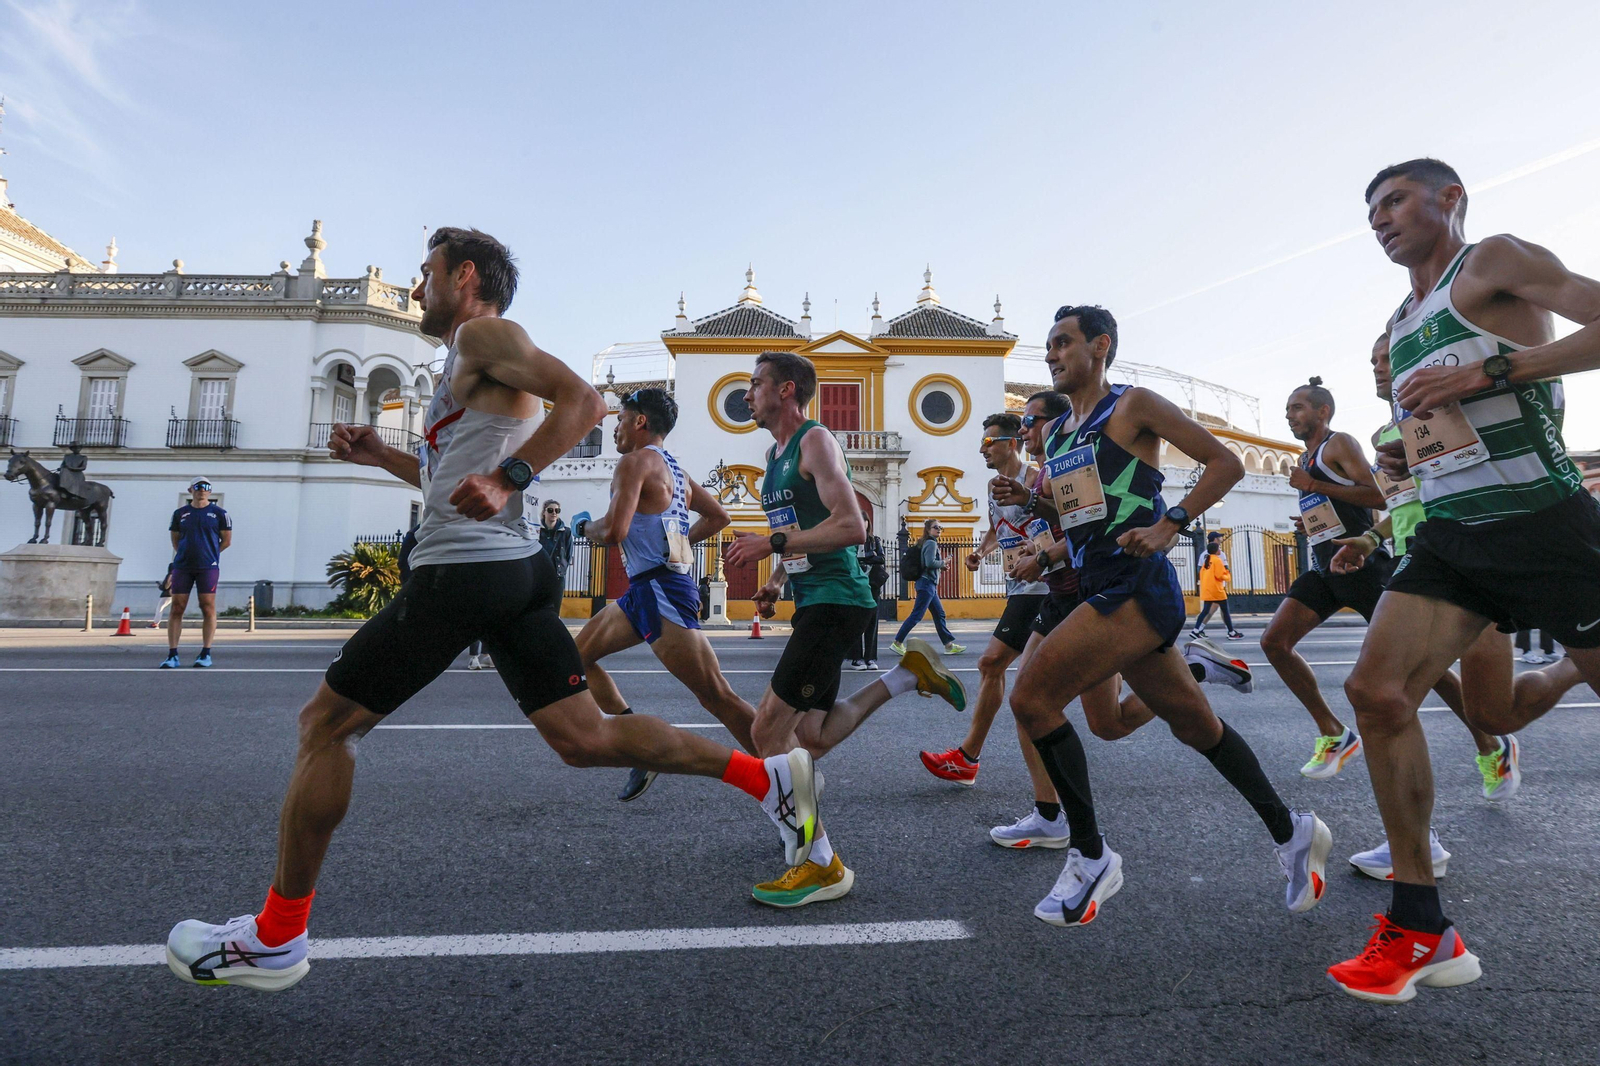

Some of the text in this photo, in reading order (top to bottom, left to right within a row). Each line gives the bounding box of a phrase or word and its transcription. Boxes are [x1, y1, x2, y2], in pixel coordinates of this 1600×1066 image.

[1414, 424, 1431, 440] 134
[1416, 441, 1445, 459] GOMES
[1053, 453, 1085, 473] ZURICH
[760, 489, 794, 505] ELAND
[1060, 483, 1074, 496] 121
[1062, 498, 1080, 511] ORTIZ
